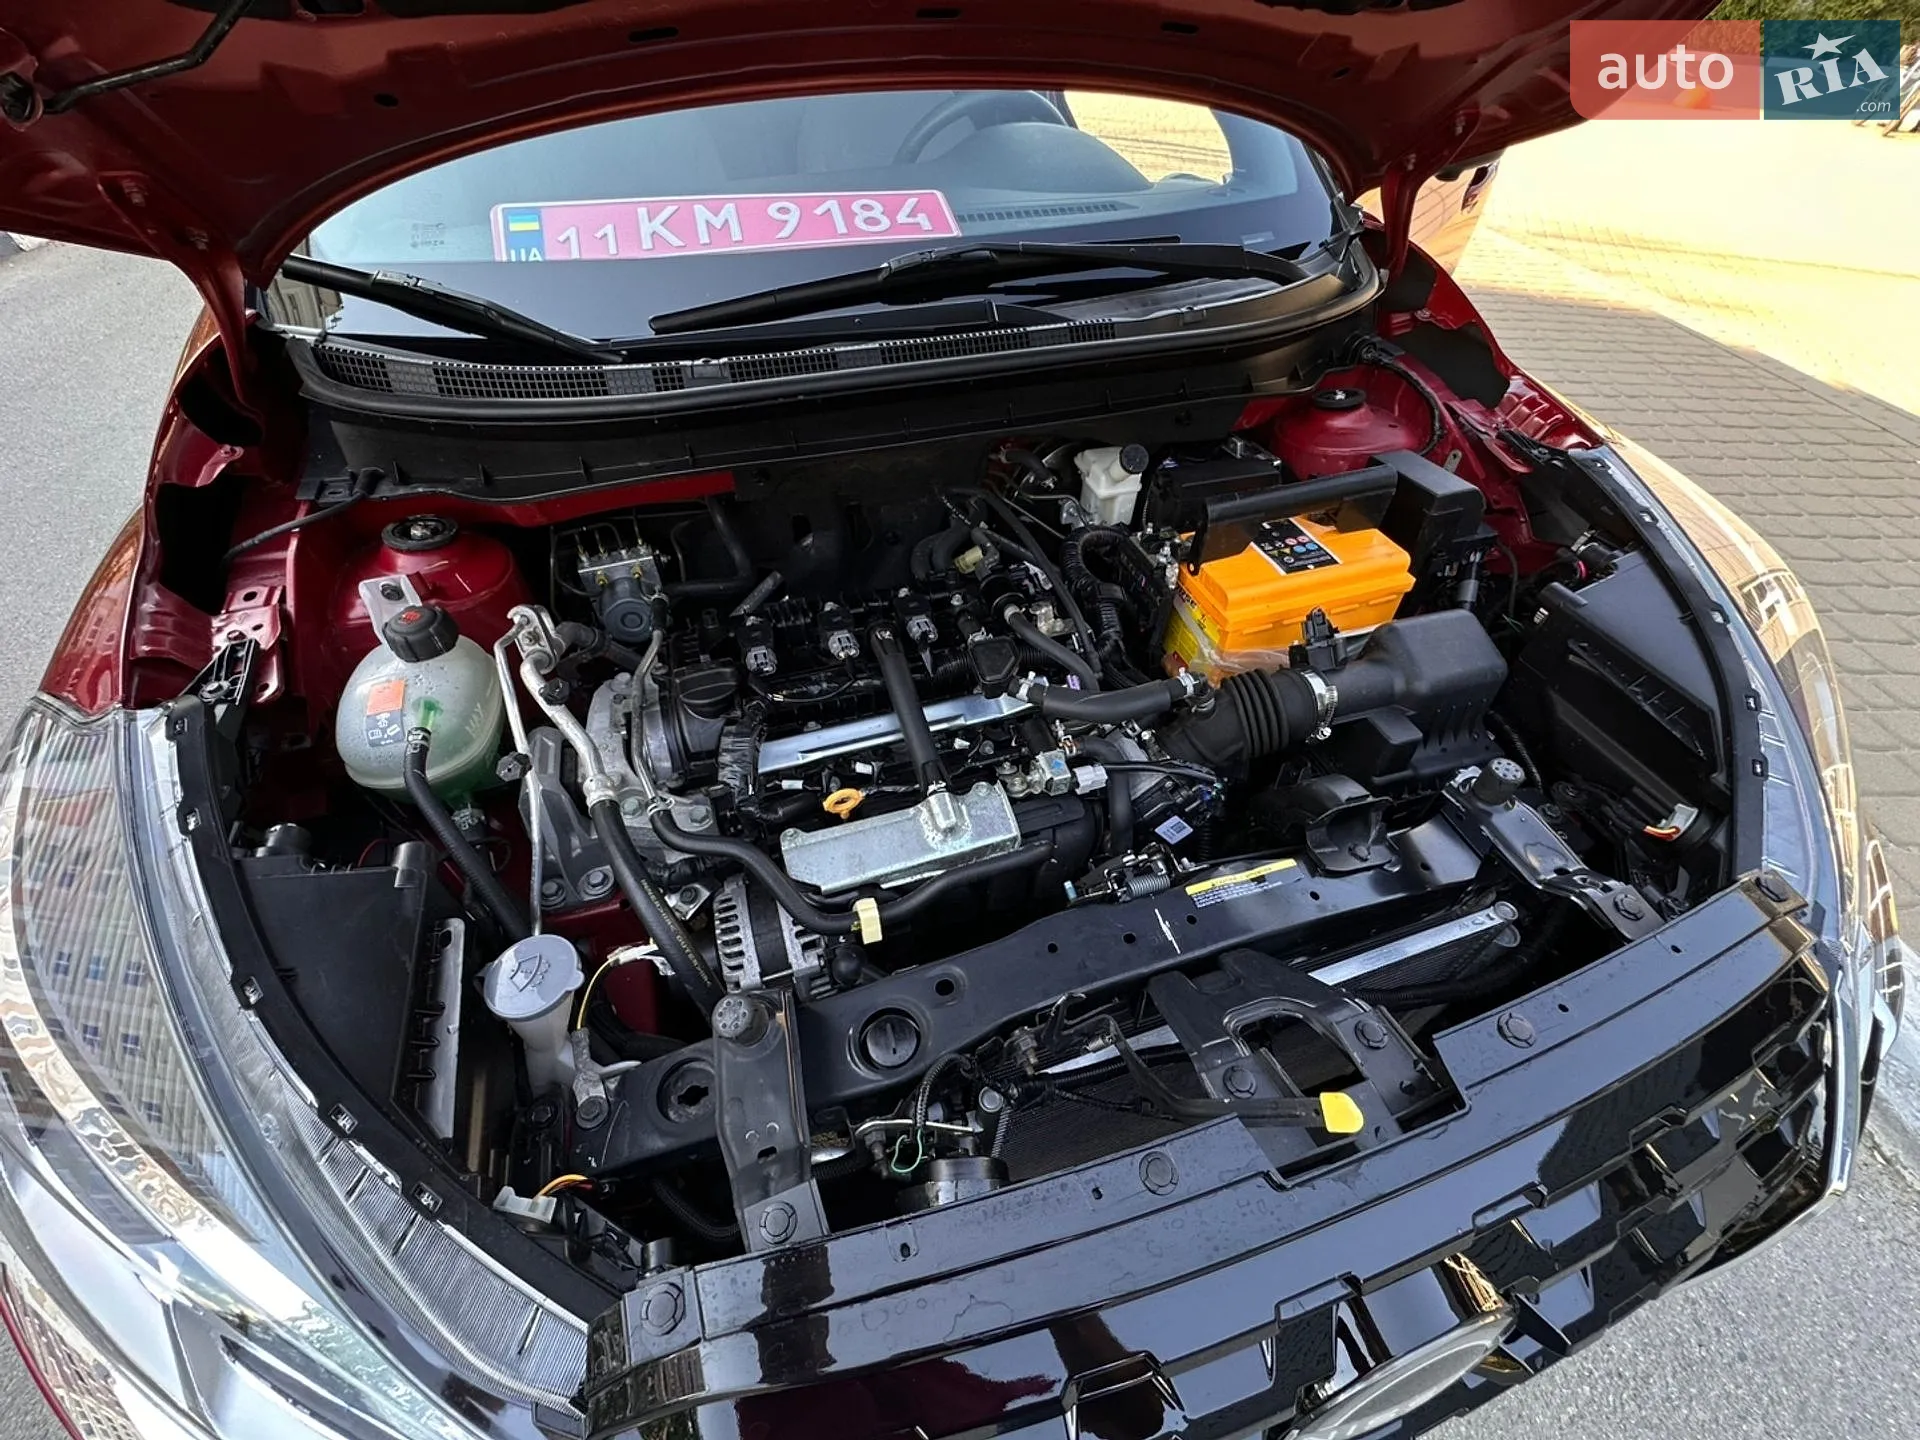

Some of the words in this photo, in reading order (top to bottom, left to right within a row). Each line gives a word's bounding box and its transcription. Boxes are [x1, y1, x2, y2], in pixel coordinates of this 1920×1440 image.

[557, 222, 618, 259] 11
[636, 204, 742, 250] KM
[767, 198, 933, 239] 9184
